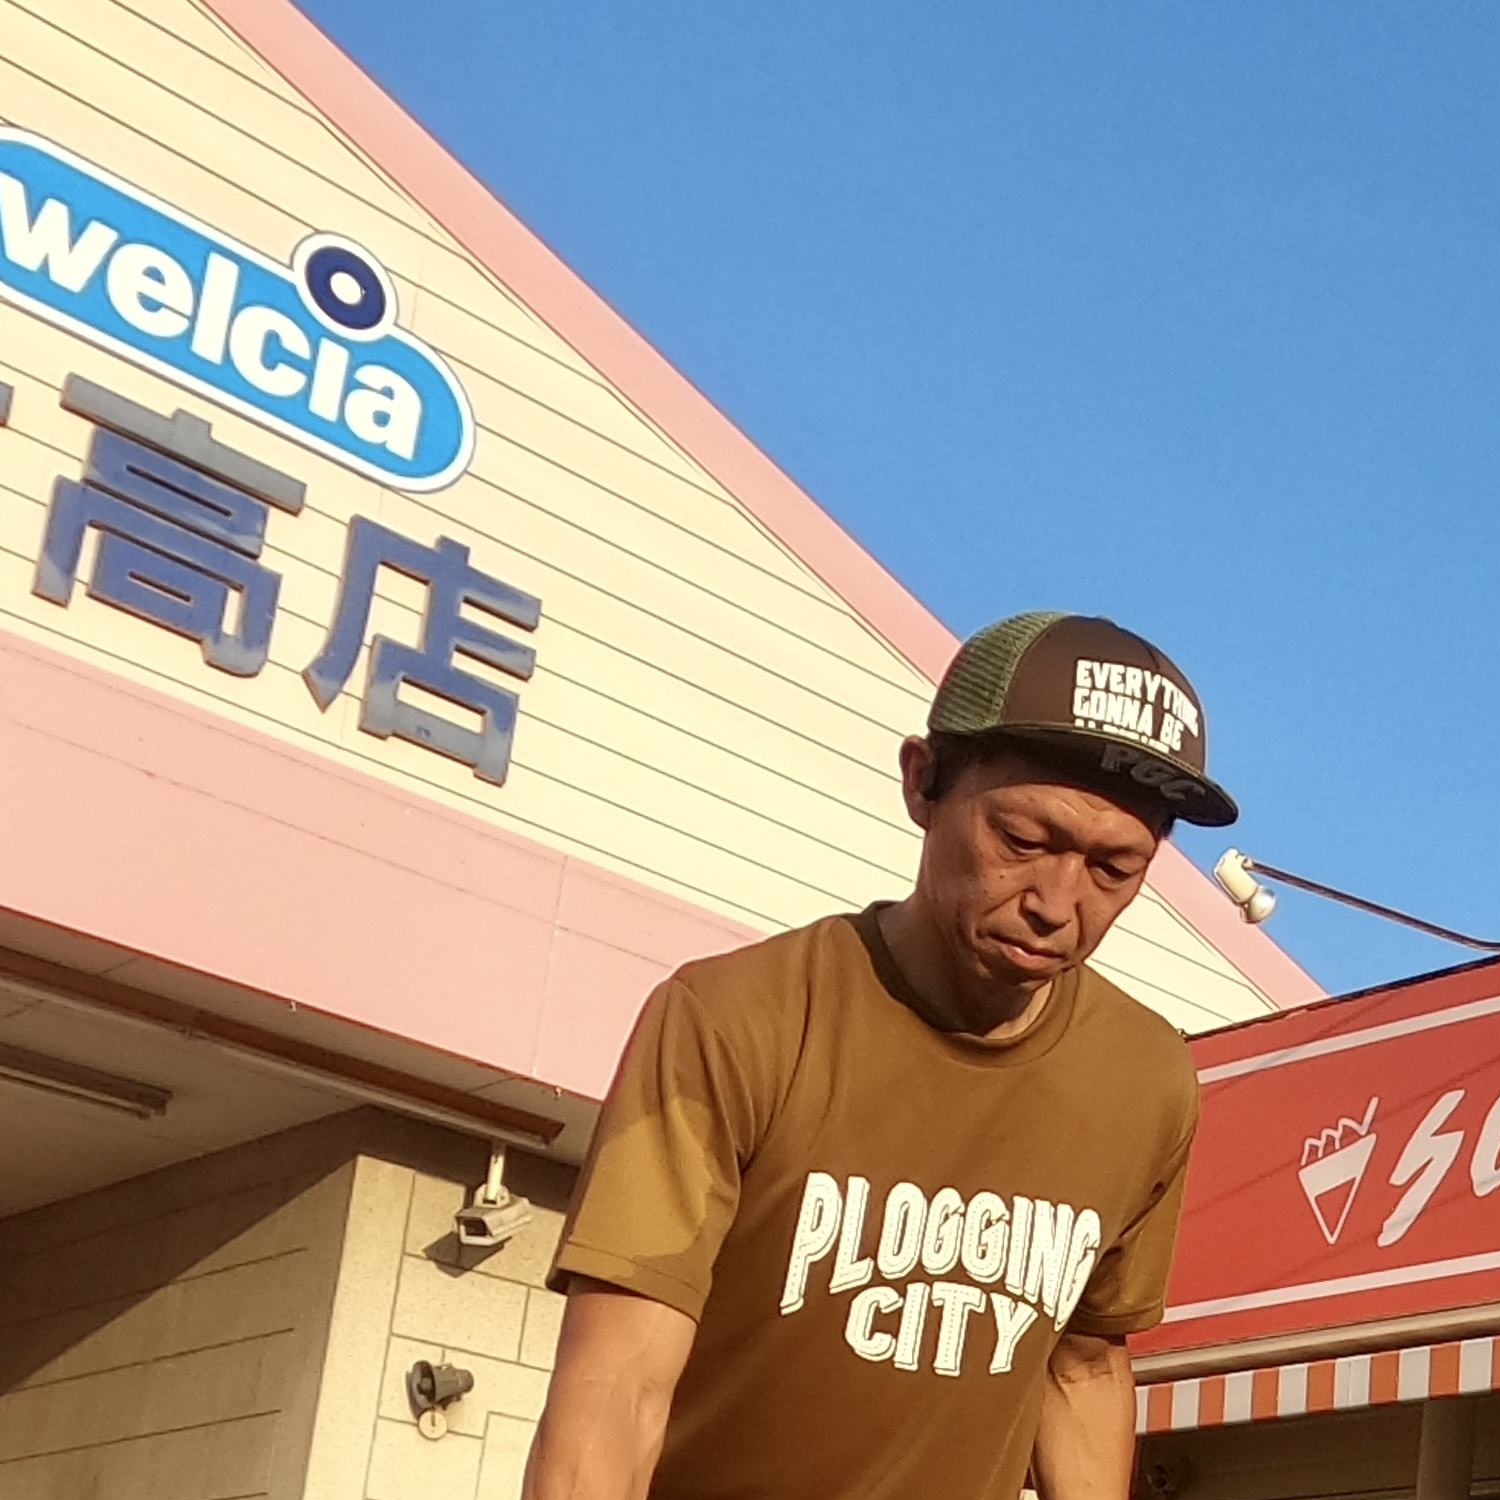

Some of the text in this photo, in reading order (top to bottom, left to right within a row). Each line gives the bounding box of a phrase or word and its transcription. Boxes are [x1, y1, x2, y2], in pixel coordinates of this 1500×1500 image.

[0, 172, 423, 461] welcia
[0, 372, 543, 787] 高店
[1072, 687, 1153, 737] GONNA
[1160, 712, 1184, 751] BE
[779, 1171, 1101, 1332] PLOGGING
[844, 1281, 1039, 1377] CITY
